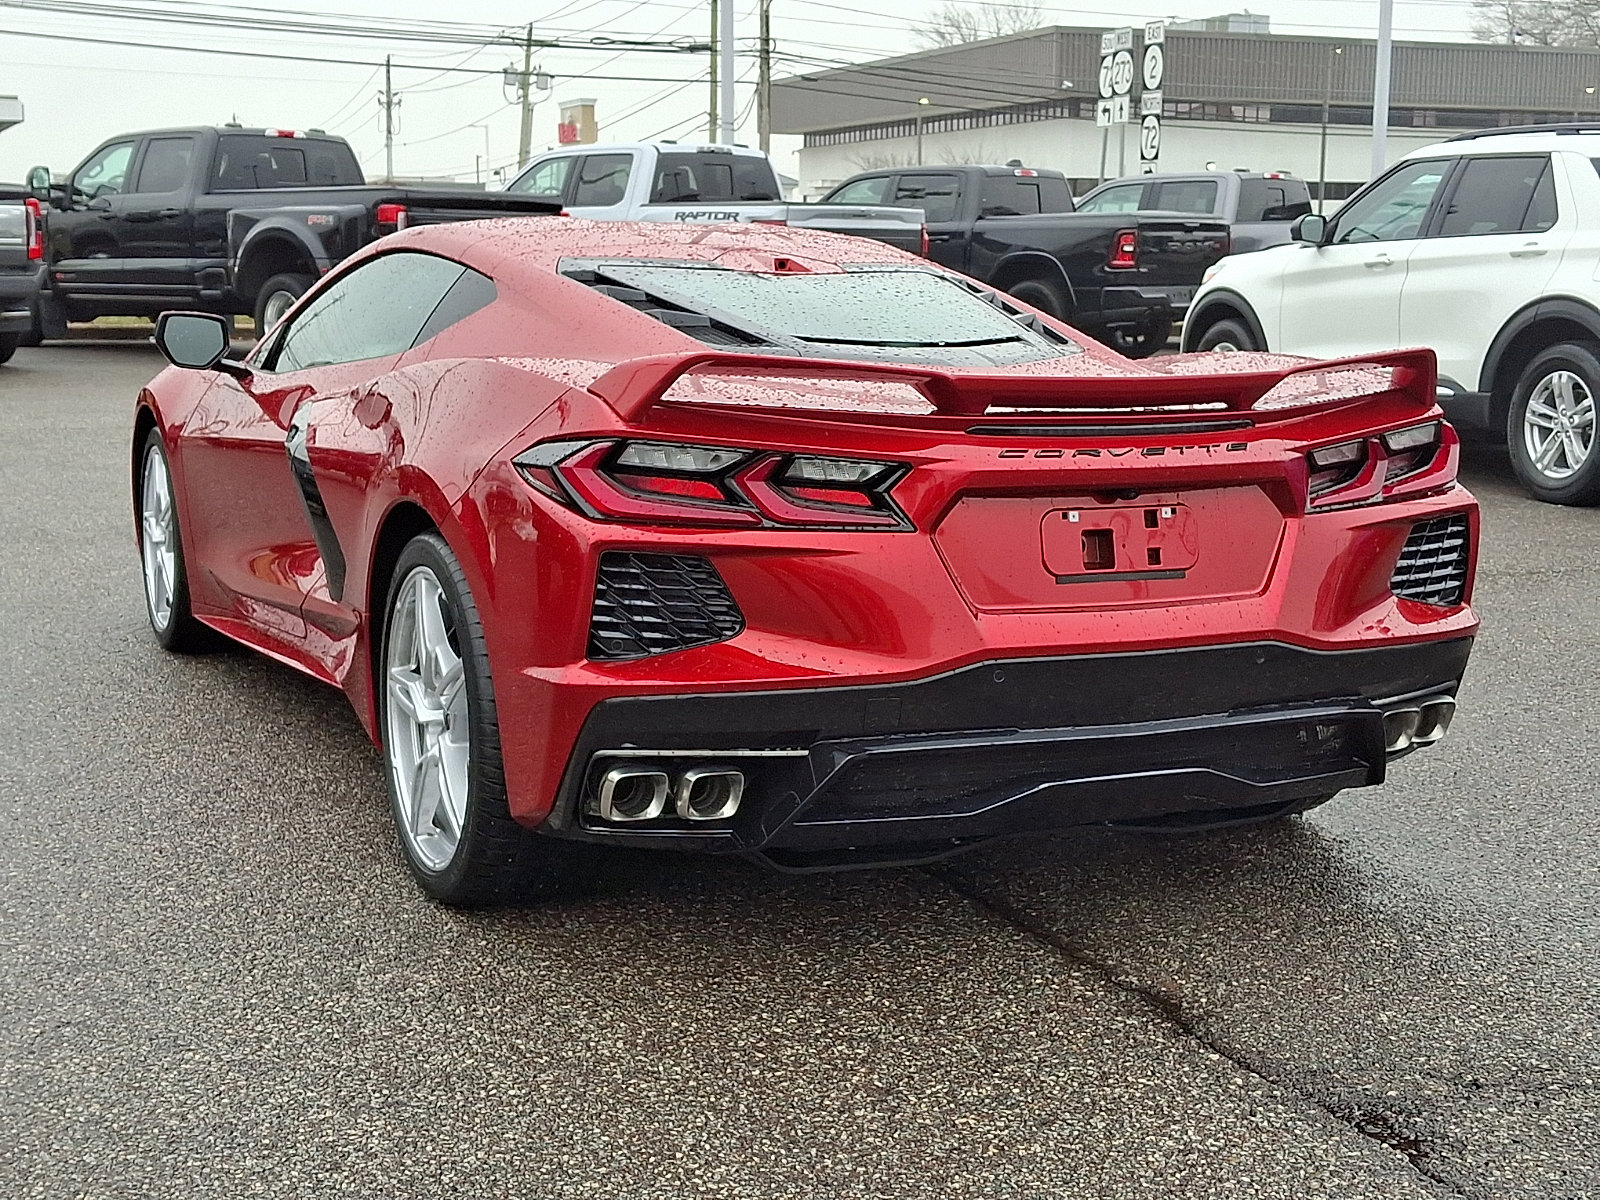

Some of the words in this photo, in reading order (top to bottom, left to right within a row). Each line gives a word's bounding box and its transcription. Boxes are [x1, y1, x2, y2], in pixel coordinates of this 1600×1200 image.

[1148, 26, 1161, 41] EAST
[1114, 60, 1132, 85] 273
[1150, 55, 1158, 79] 2
[1144, 125, 1158, 150] 72
[674, 211, 740, 222] RAPTOR
[998, 442, 1249, 459] CORVETTE
